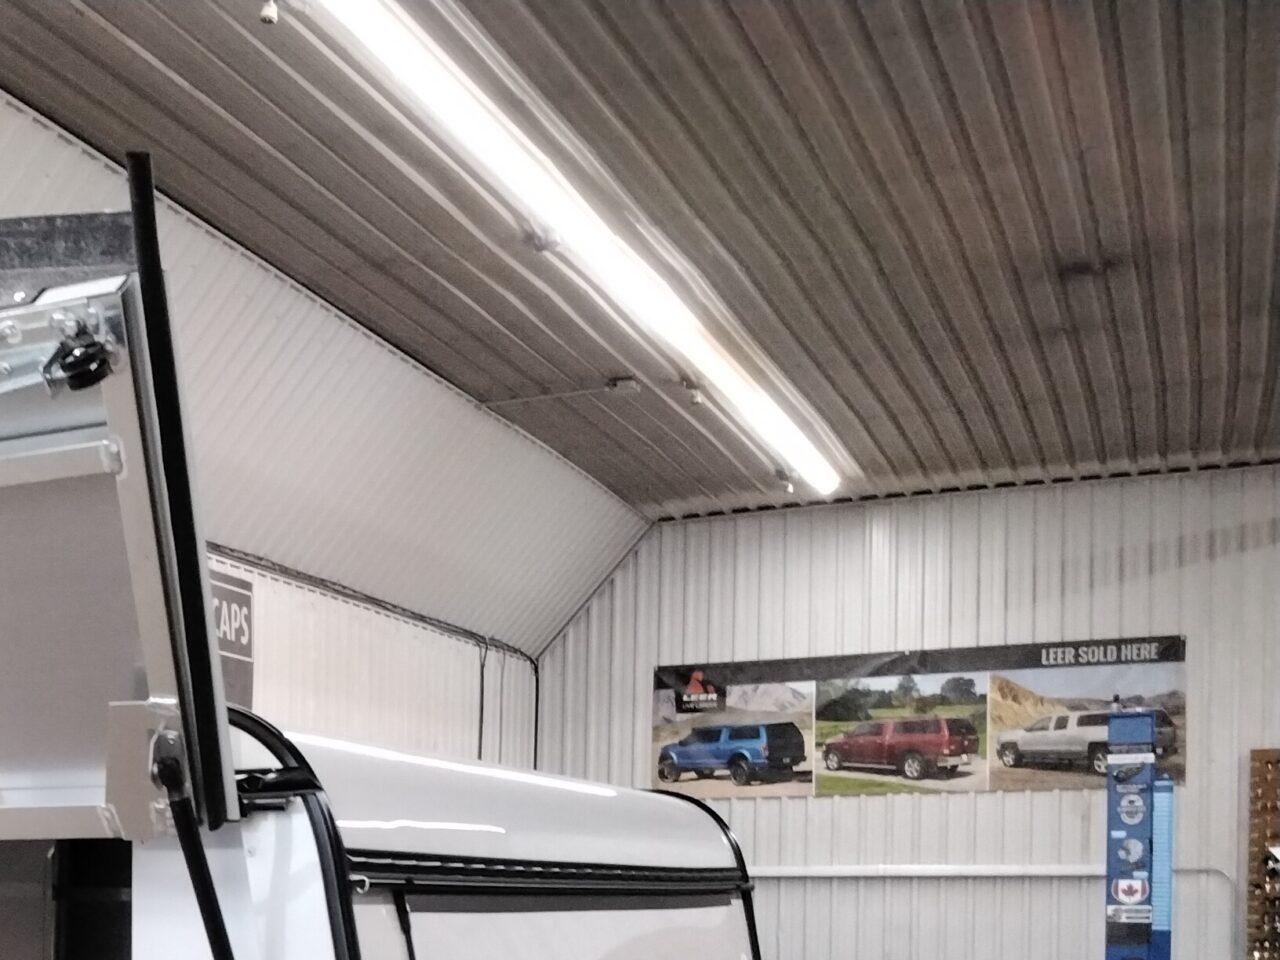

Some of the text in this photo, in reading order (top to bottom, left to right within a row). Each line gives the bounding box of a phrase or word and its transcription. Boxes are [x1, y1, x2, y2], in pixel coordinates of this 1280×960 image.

[1041, 642, 1160, 665] LEER SOLD HERE
